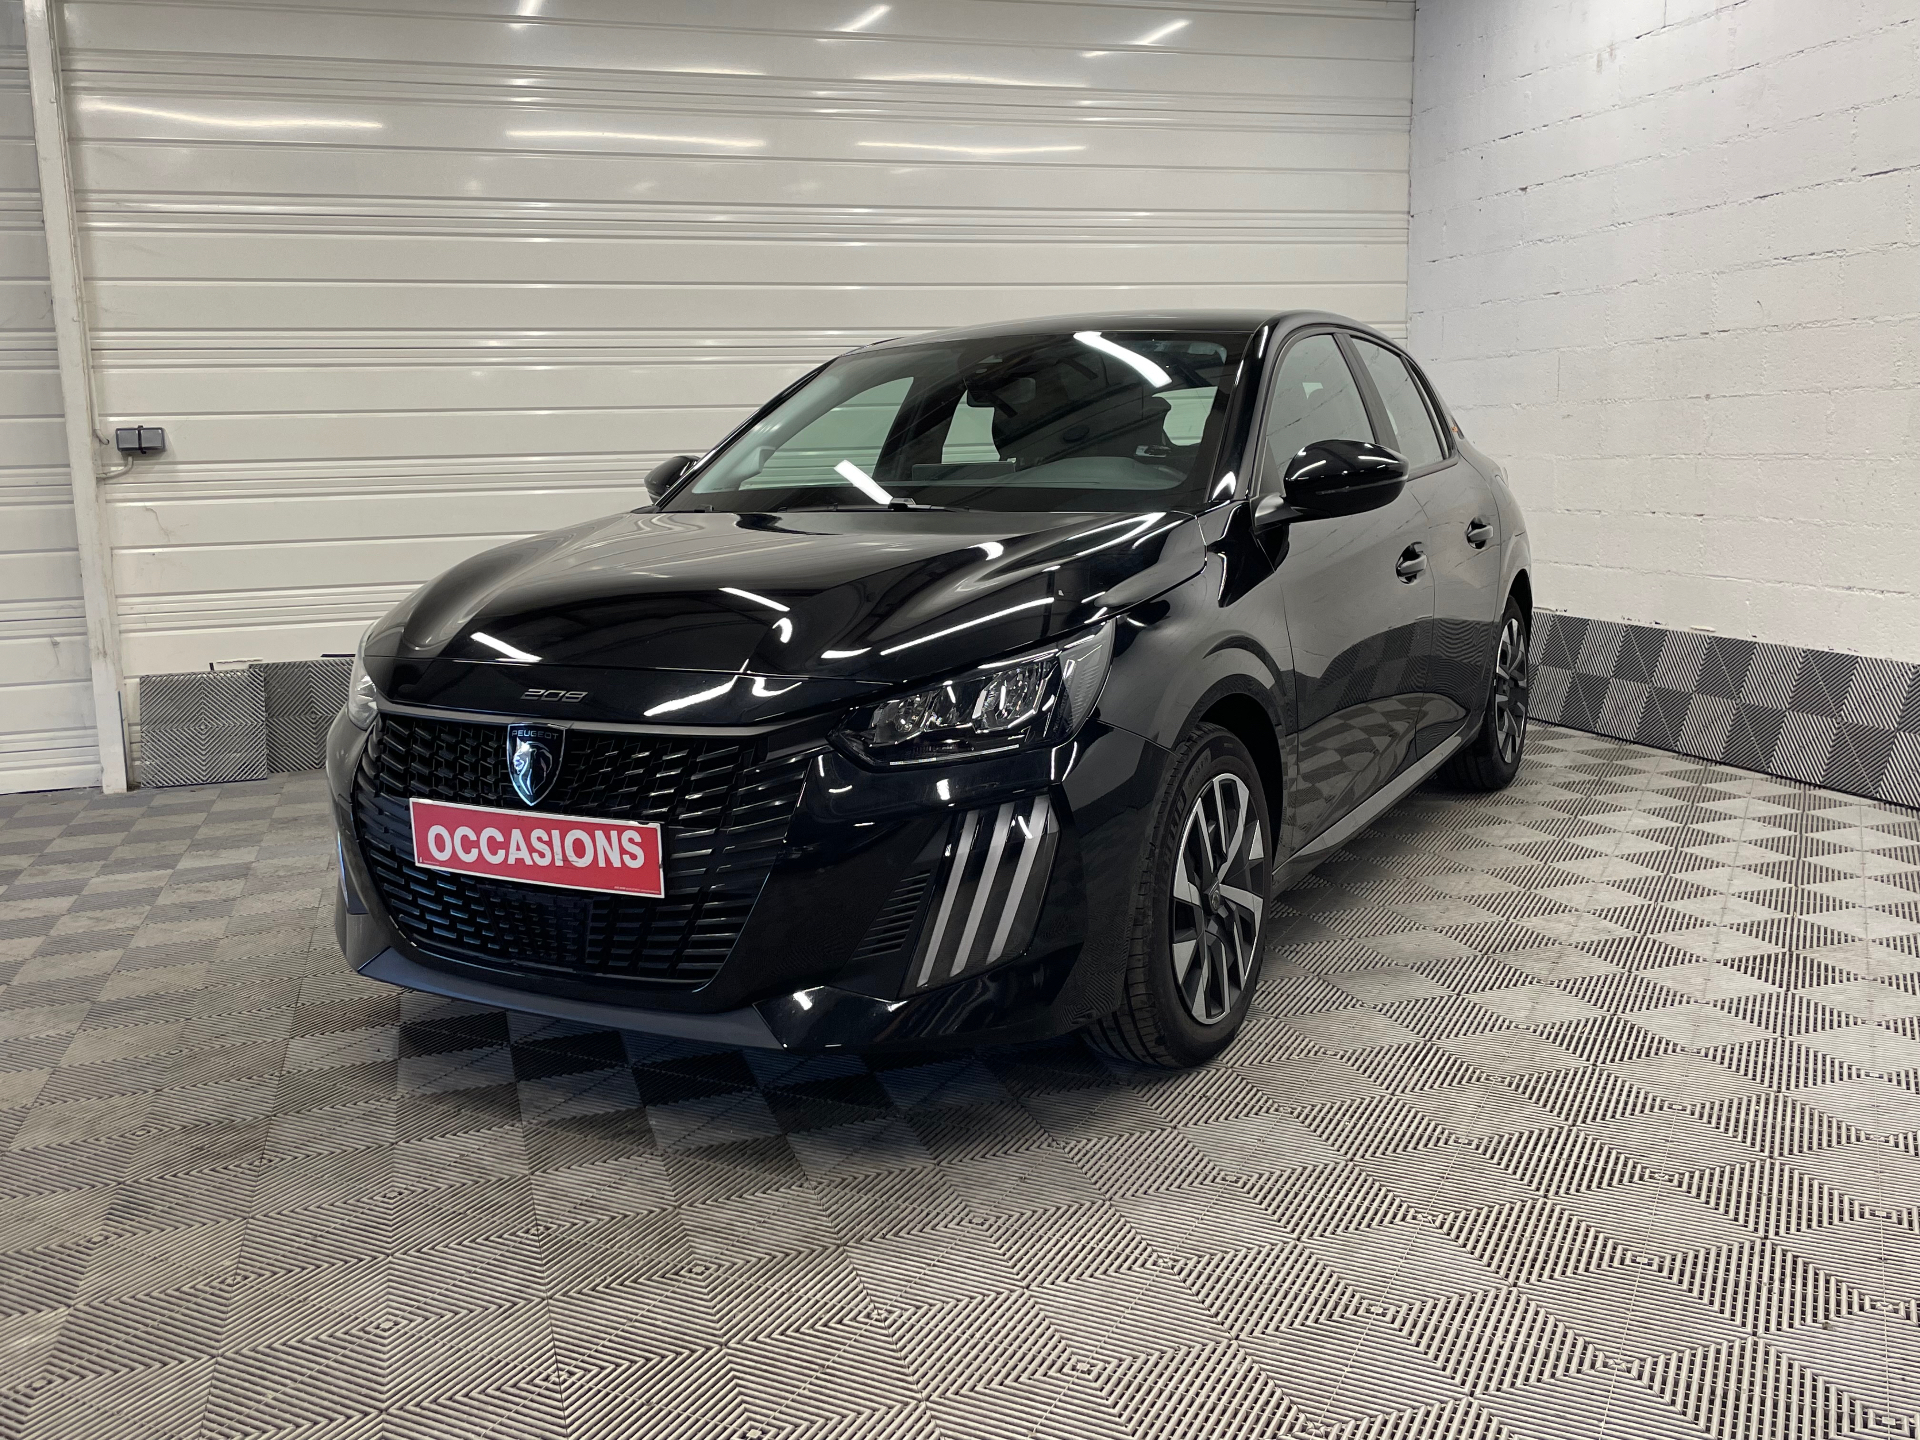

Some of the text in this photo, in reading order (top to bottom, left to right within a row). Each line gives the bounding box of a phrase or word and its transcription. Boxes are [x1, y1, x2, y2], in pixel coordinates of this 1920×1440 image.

[520, 688, 588, 702] 208
[511, 729, 559, 739] PEUGEOT
[428, 825, 645, 868] OCCASIONS
